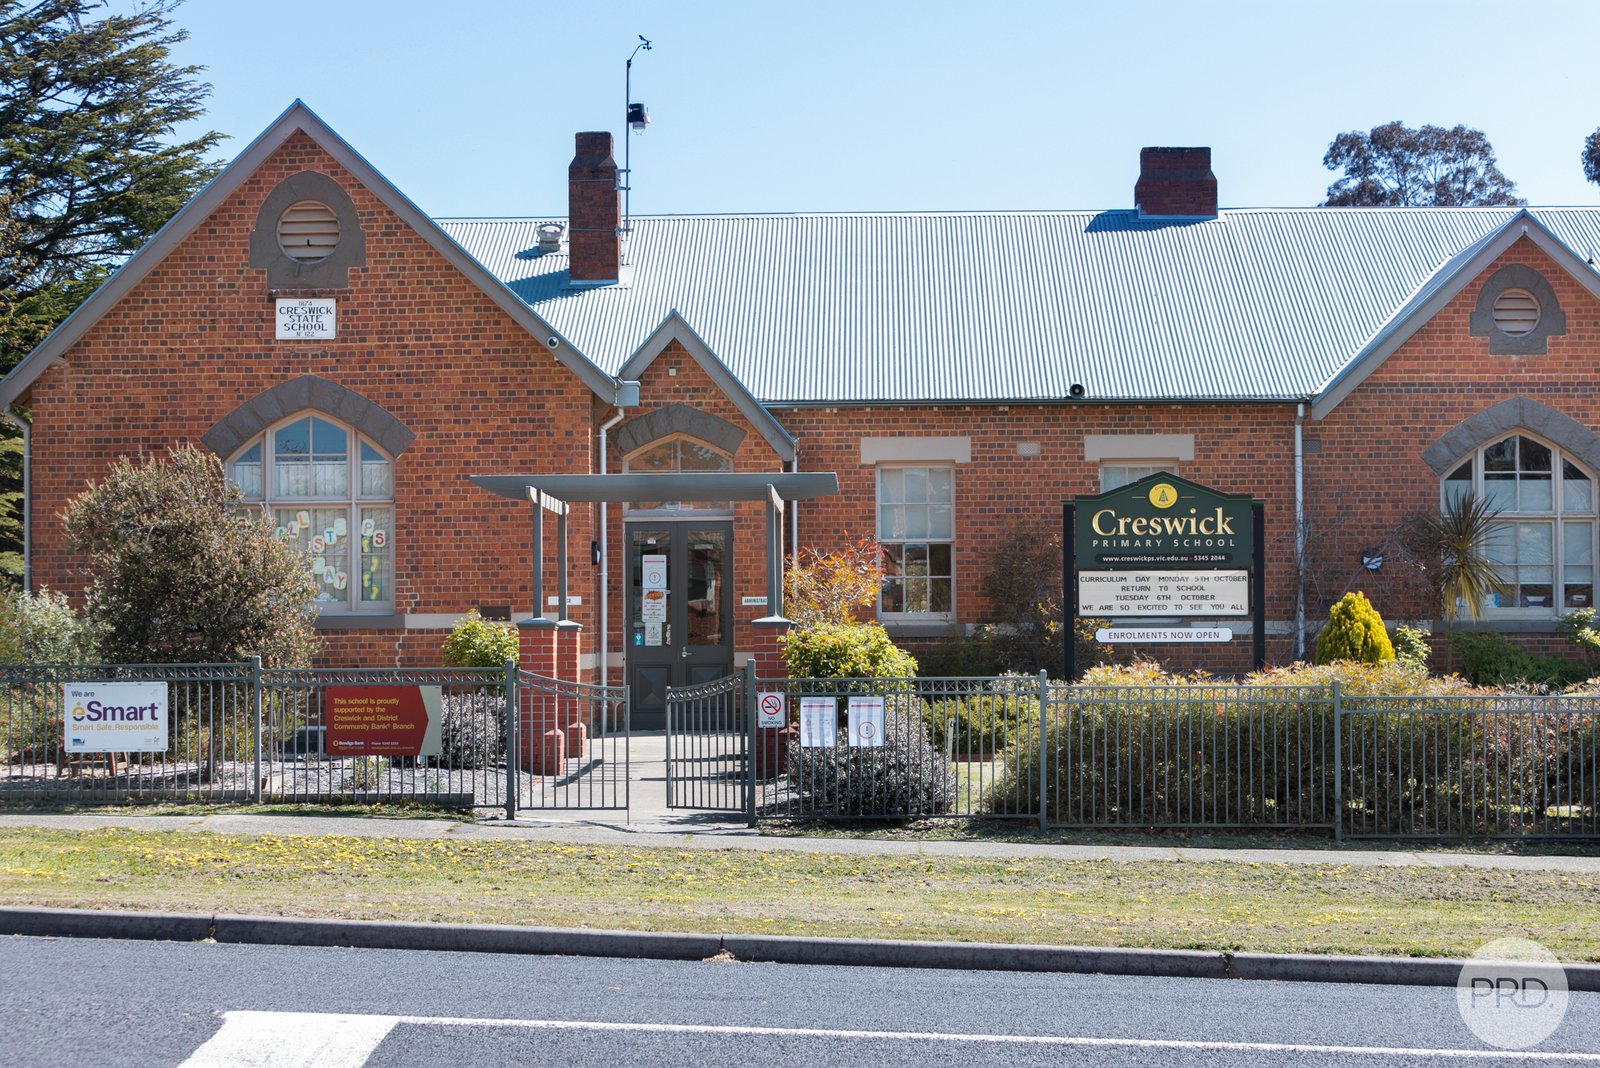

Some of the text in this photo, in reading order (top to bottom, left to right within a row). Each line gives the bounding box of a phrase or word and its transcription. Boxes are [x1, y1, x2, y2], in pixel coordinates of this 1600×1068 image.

[279, 306, 332, 315] CRESWICK
[289, 315, 323, 323] STATE
[284, 323, 328, 331] SCHOOL
[1092, 507, 1236, 536] Creswick
[1173, 539, 1234, 547] SCHOOL
[1108, 632, 1168, 640] ENROLMENTS
[1196, 631, 1220, 639] OPEN
[376, 698, 400, 706] proudly
[72, 701, 158, 721] eSmart
